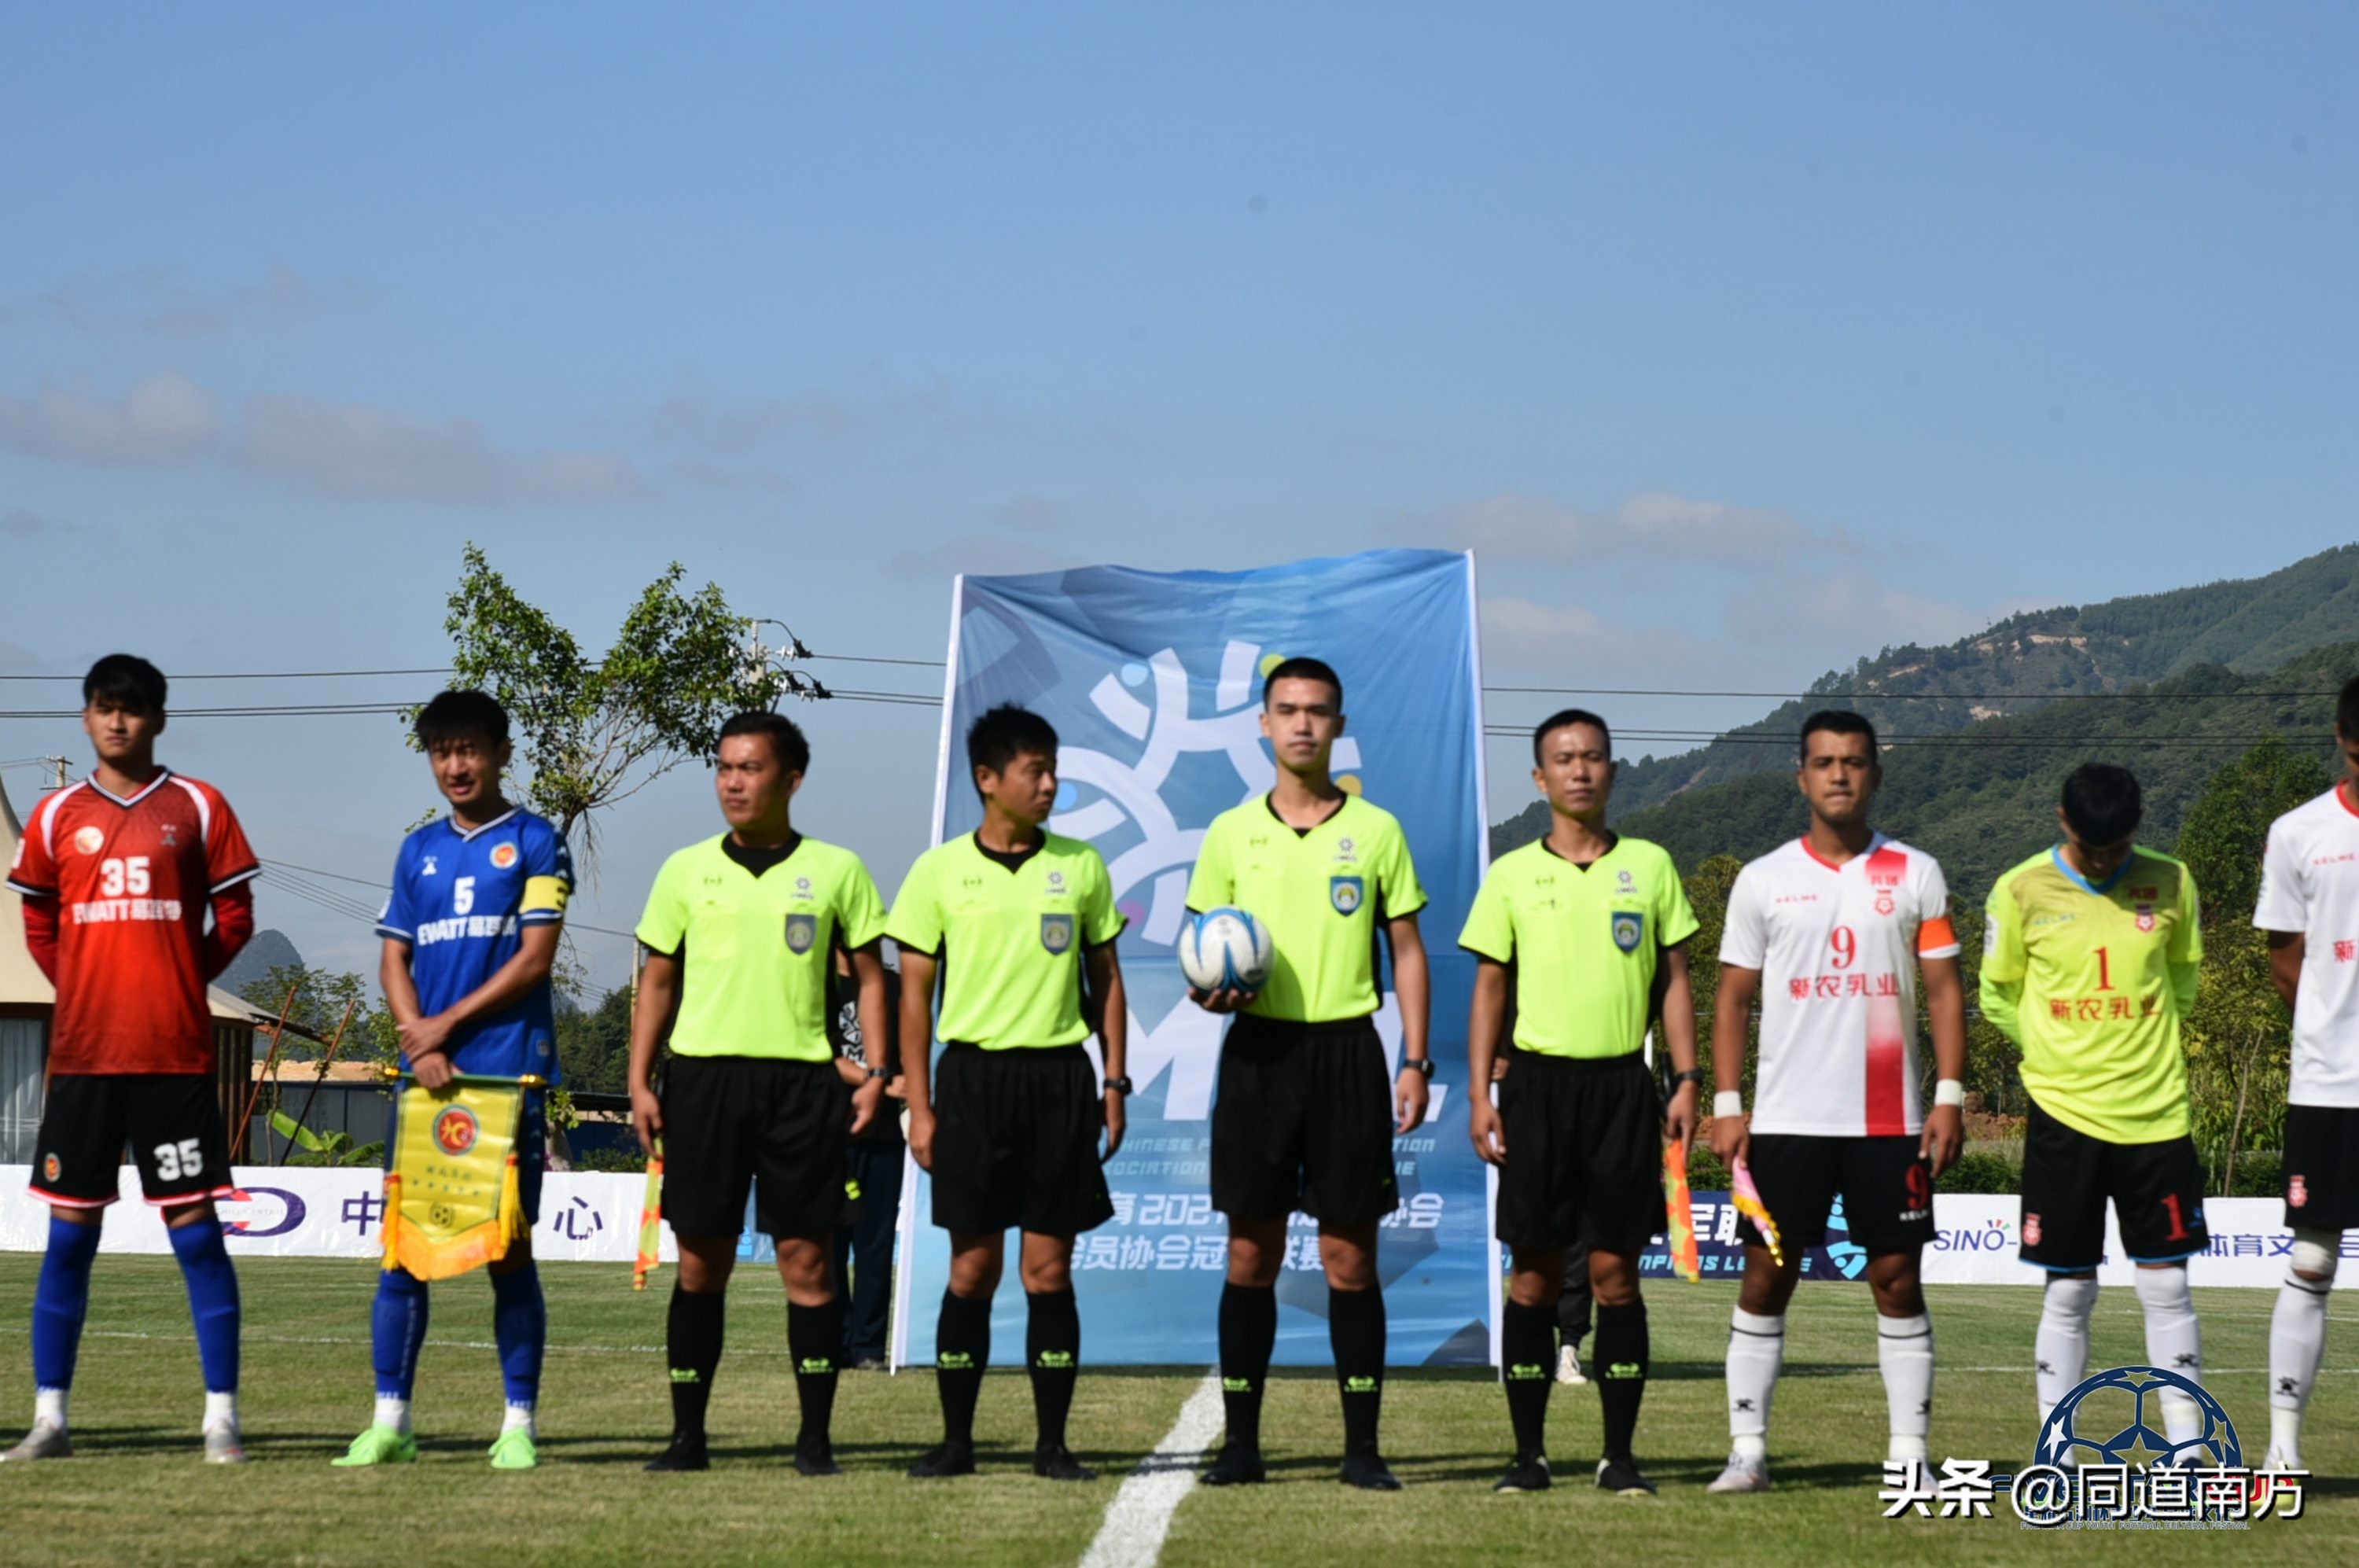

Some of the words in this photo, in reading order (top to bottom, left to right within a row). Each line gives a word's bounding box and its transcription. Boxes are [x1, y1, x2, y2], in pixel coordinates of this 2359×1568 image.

[101, 856, 150, 897] 35
[454, 876, 476, 915] 5
[1831, 926, 1856, 970] 9
[2093, 946, 2114, 992] 1
[1789, 974, 1900, 1000] 新农乳业
[2050, 995, 2161, 1021] 新农乳业
[153, 1138, 203, 1181] 35
[1905, 1164, 1928, 1209] 9
[554, 1196, 603, 1240] 心
[2160, 1193, 2188, 1241] 1
